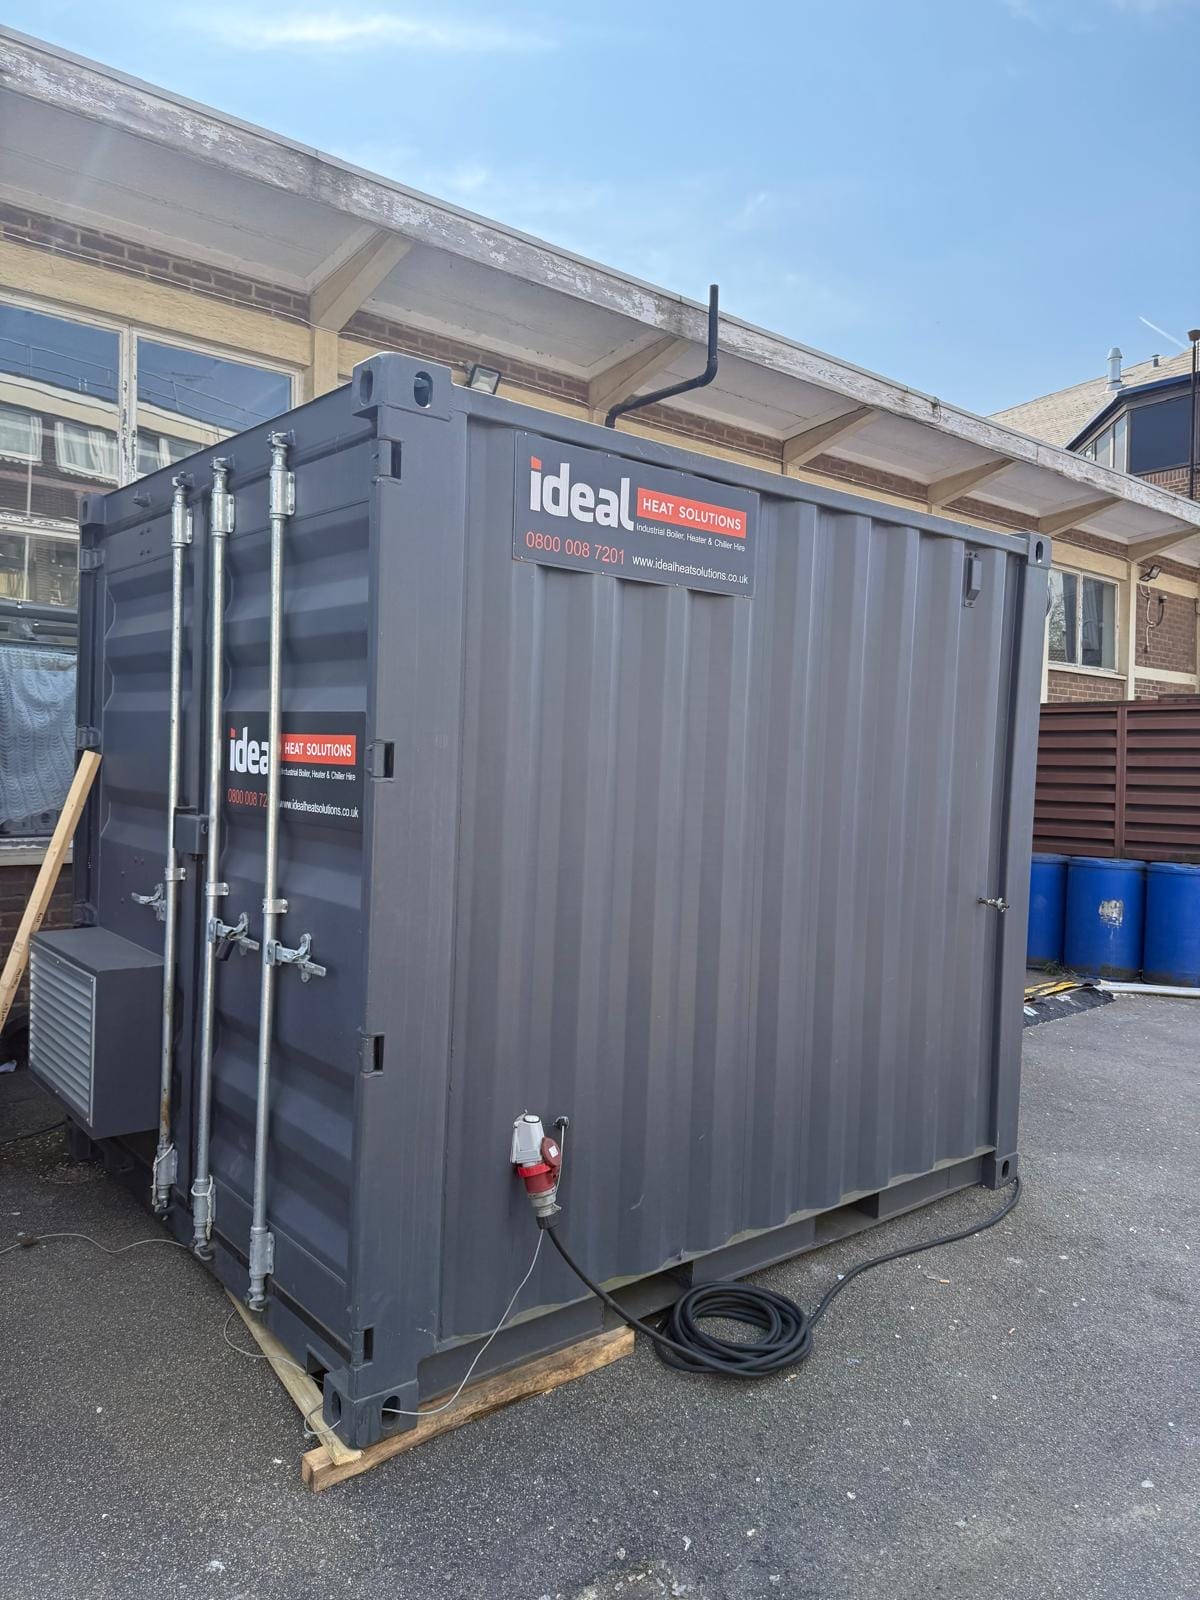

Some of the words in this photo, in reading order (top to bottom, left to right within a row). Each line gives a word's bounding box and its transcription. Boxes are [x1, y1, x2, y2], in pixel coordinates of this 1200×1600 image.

[529, 455, 634, 531] ideal
[642, 497, 675, 516] HEAT
[678, 505, 742, 531] SOLUTIONS
[526, 531, 561, 553] 0800
[565, 538, 590, 558] 008
[594, 544, 625, 565] 7201
[636, 522, 666, 537] Industrial
[666, 528, 686, 541] Boiler,
[686, 533, 707, 545] Heater
[707, 537, 713, 546] &
[714, 538, 733, 550] Chiller
[733, 543, 746, 552] Hire
[632, 555, 749, 584] www.idealheatsolutions.co.uk
[229, 727, 269, 775] idea
[284, 742, 304, 755] HEAT
[306, 743, 352, 757] SOLUTIONS
[312, 769, 326, 779] Heater
[331, 771, 346, 780] Chiller
[346, 772, 356, 781] Hire
[228, 788, 244, 804] 0800
[244, 790, 257, 806] 008
[259, 792, 269, 808] 72
